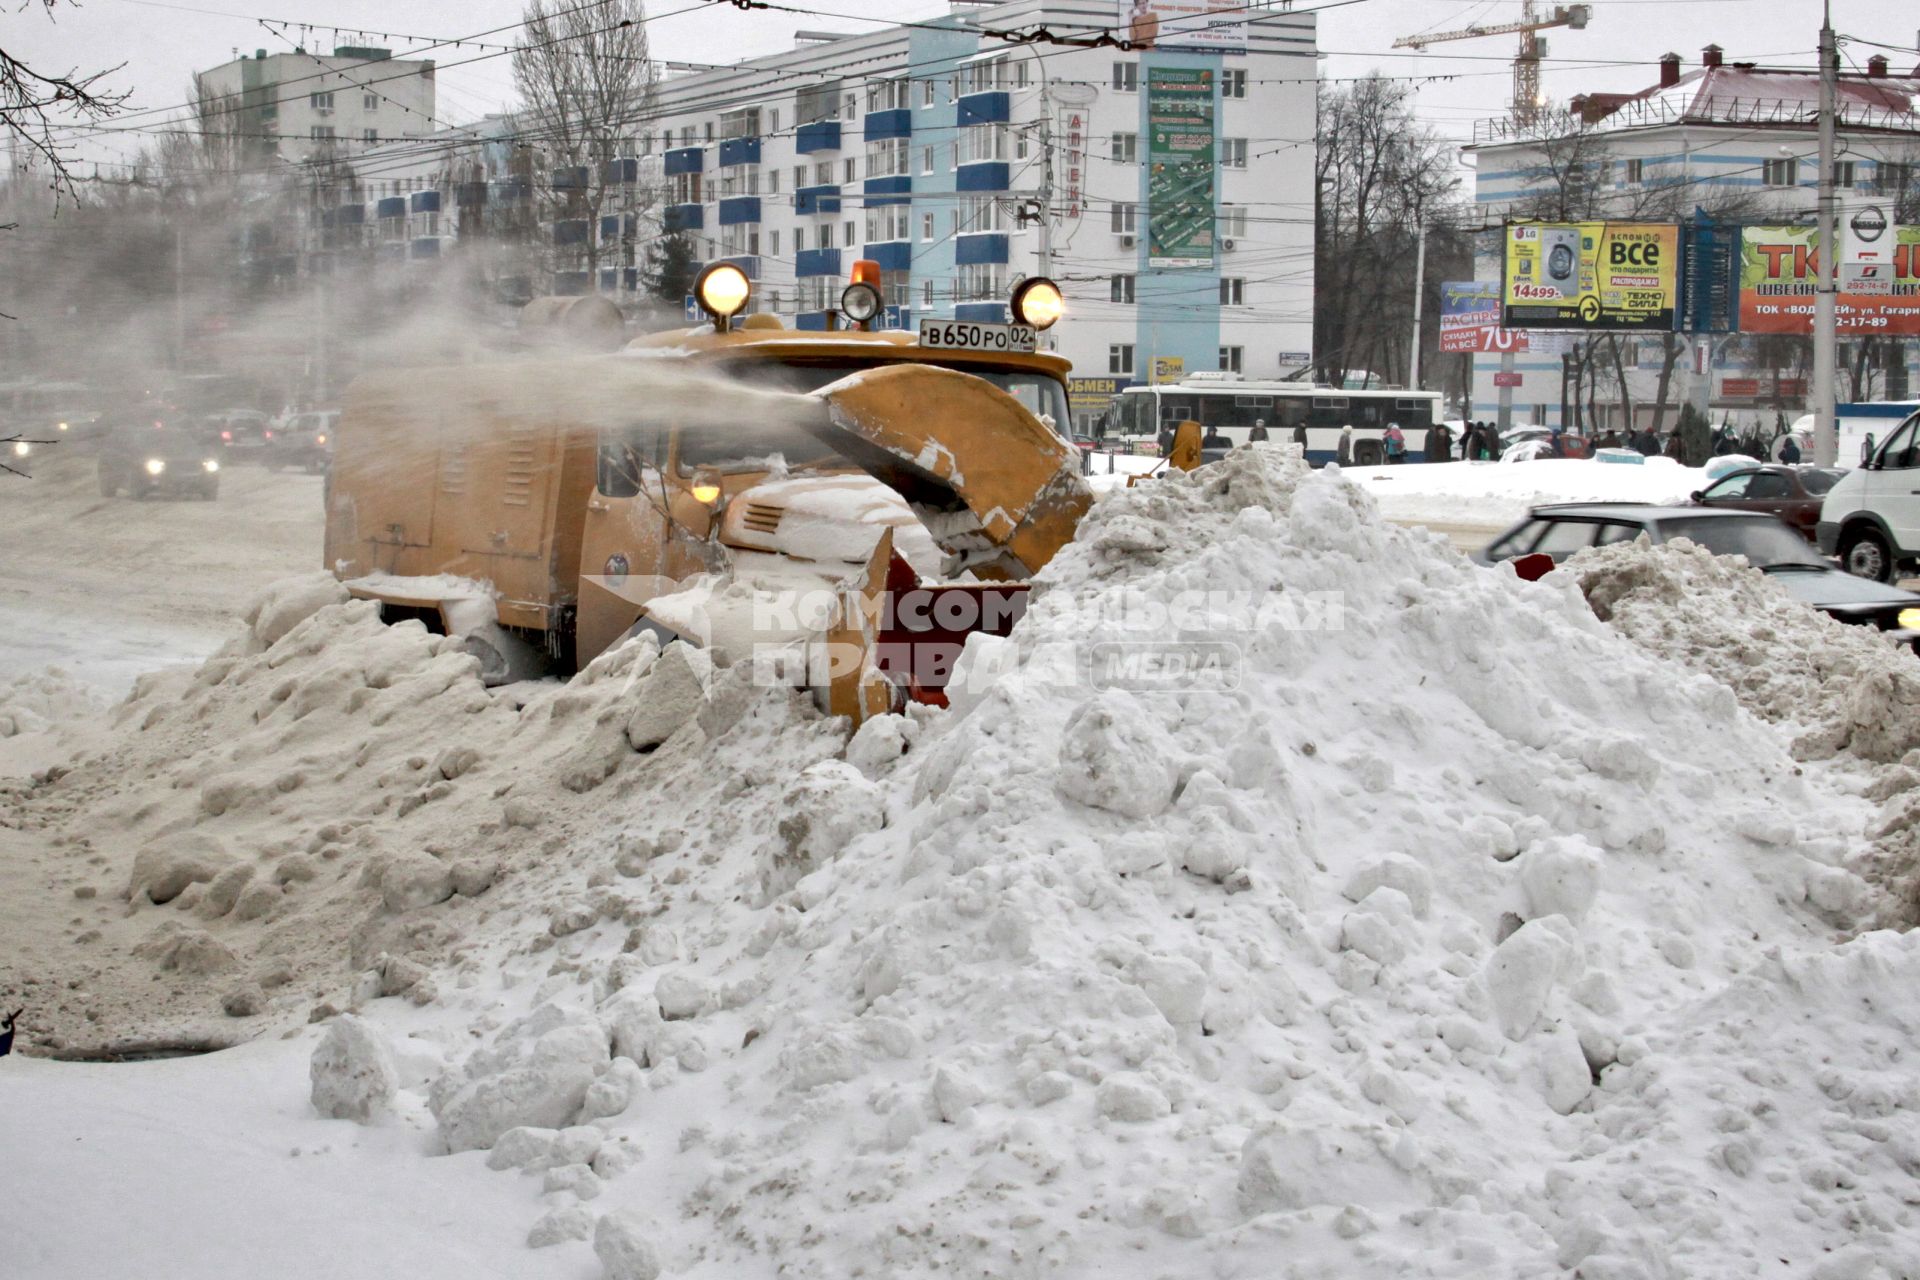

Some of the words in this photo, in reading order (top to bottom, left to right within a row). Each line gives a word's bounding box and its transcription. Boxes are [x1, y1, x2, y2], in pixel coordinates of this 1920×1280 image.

[1066, 114, 1081, 218] АПТЕКА
[1525, 230, 1536, 238] LG
[1757, 244, 1920, 279] ТКН
[1611, 278, 1658, 286] РАСПРОДАЖА!
[1627, 291, 1662, 299] ТЕХНО
[1628, 299, 1658, 308] СИЛА
[1756, 305, 1779, 314] ТОК
[1783, 305, 1856, 315] «ВОДЕЙ»
[1861, 308, 1876, 316] ул.
[1879, 305, 1920, 317] Гагари
[1443, 311, 1501, 329] РАСПРО
[1010, 327, 1029, 344] 02
[1443, 331, 1477, 341] СКИДКИ
[1459, 340, 1478, 349] ВСЕ
